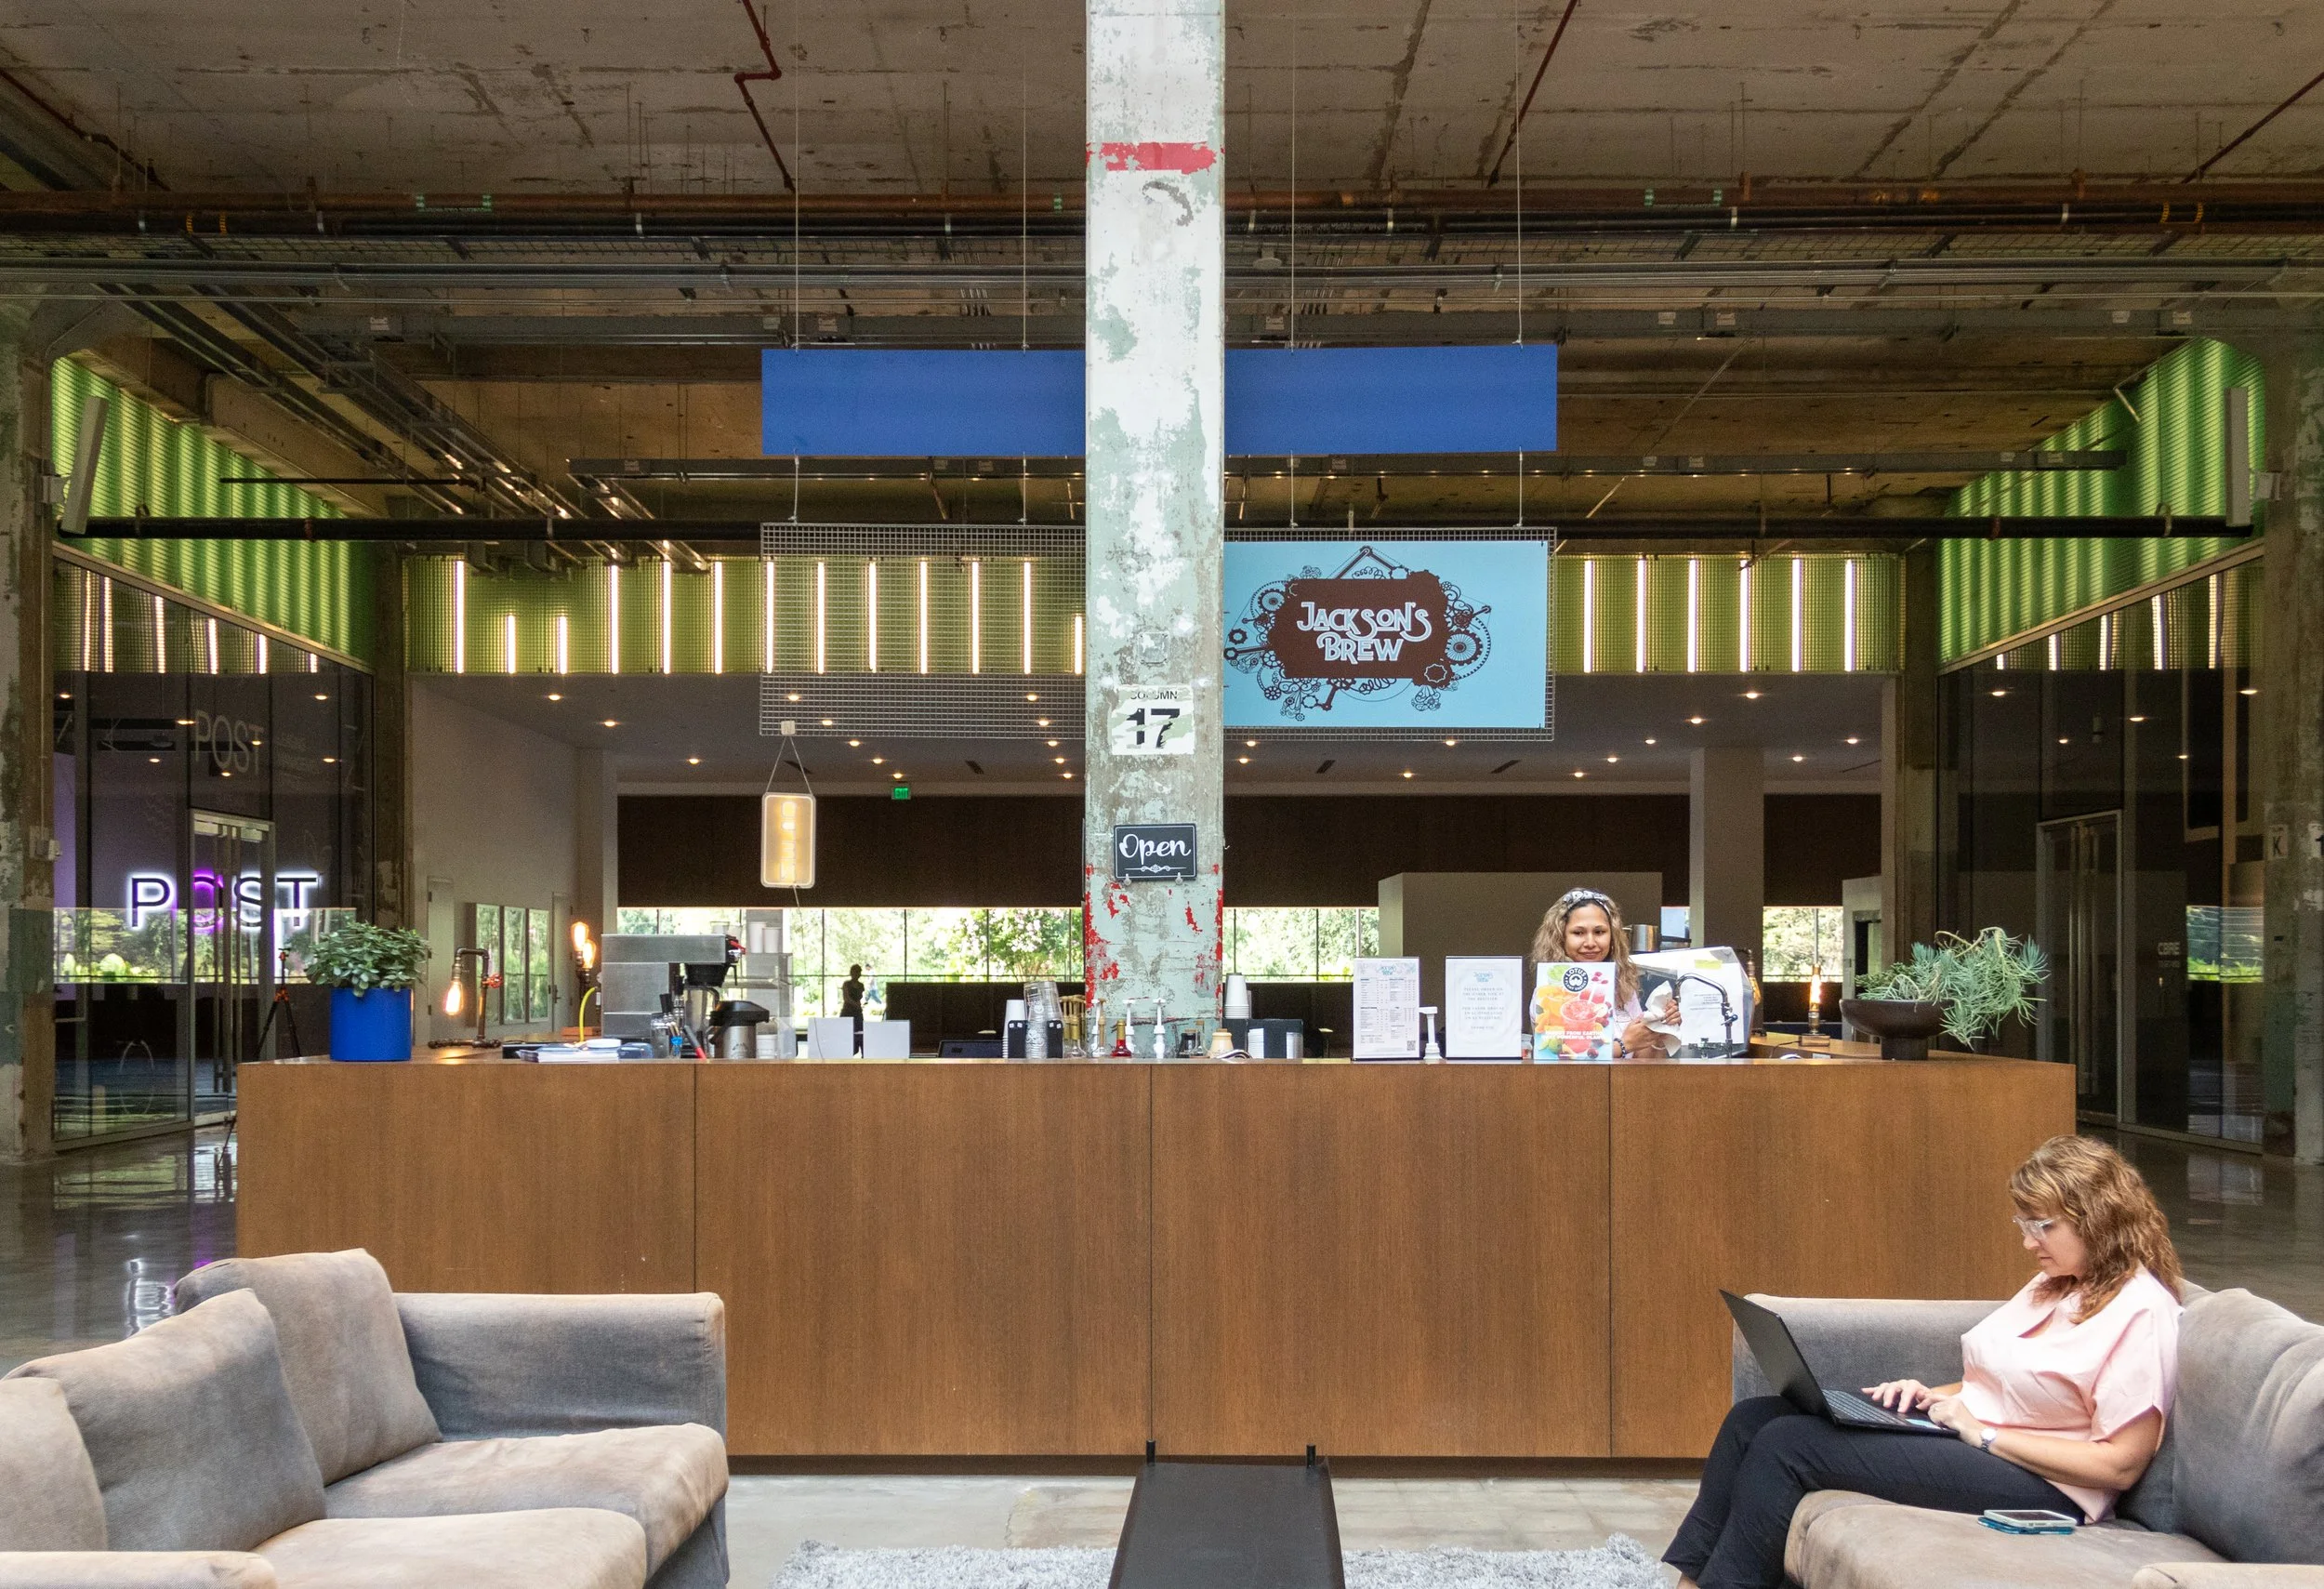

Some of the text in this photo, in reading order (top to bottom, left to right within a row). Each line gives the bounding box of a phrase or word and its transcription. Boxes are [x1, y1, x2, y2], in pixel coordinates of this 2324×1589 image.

[1297, 602, 1433, 642] JACKSON'S
[1316, 631, 1404, 665] BREW
[1130, 691, 1178, 699] COUMN
[195, 709, 264, 774] POST
[1126, 708, 1180, 748] 17
[1119, 833, 1191, 865] Open
[131, 876, 317, 927] POST
[1565, 968, 1586, 977] LOTUS
